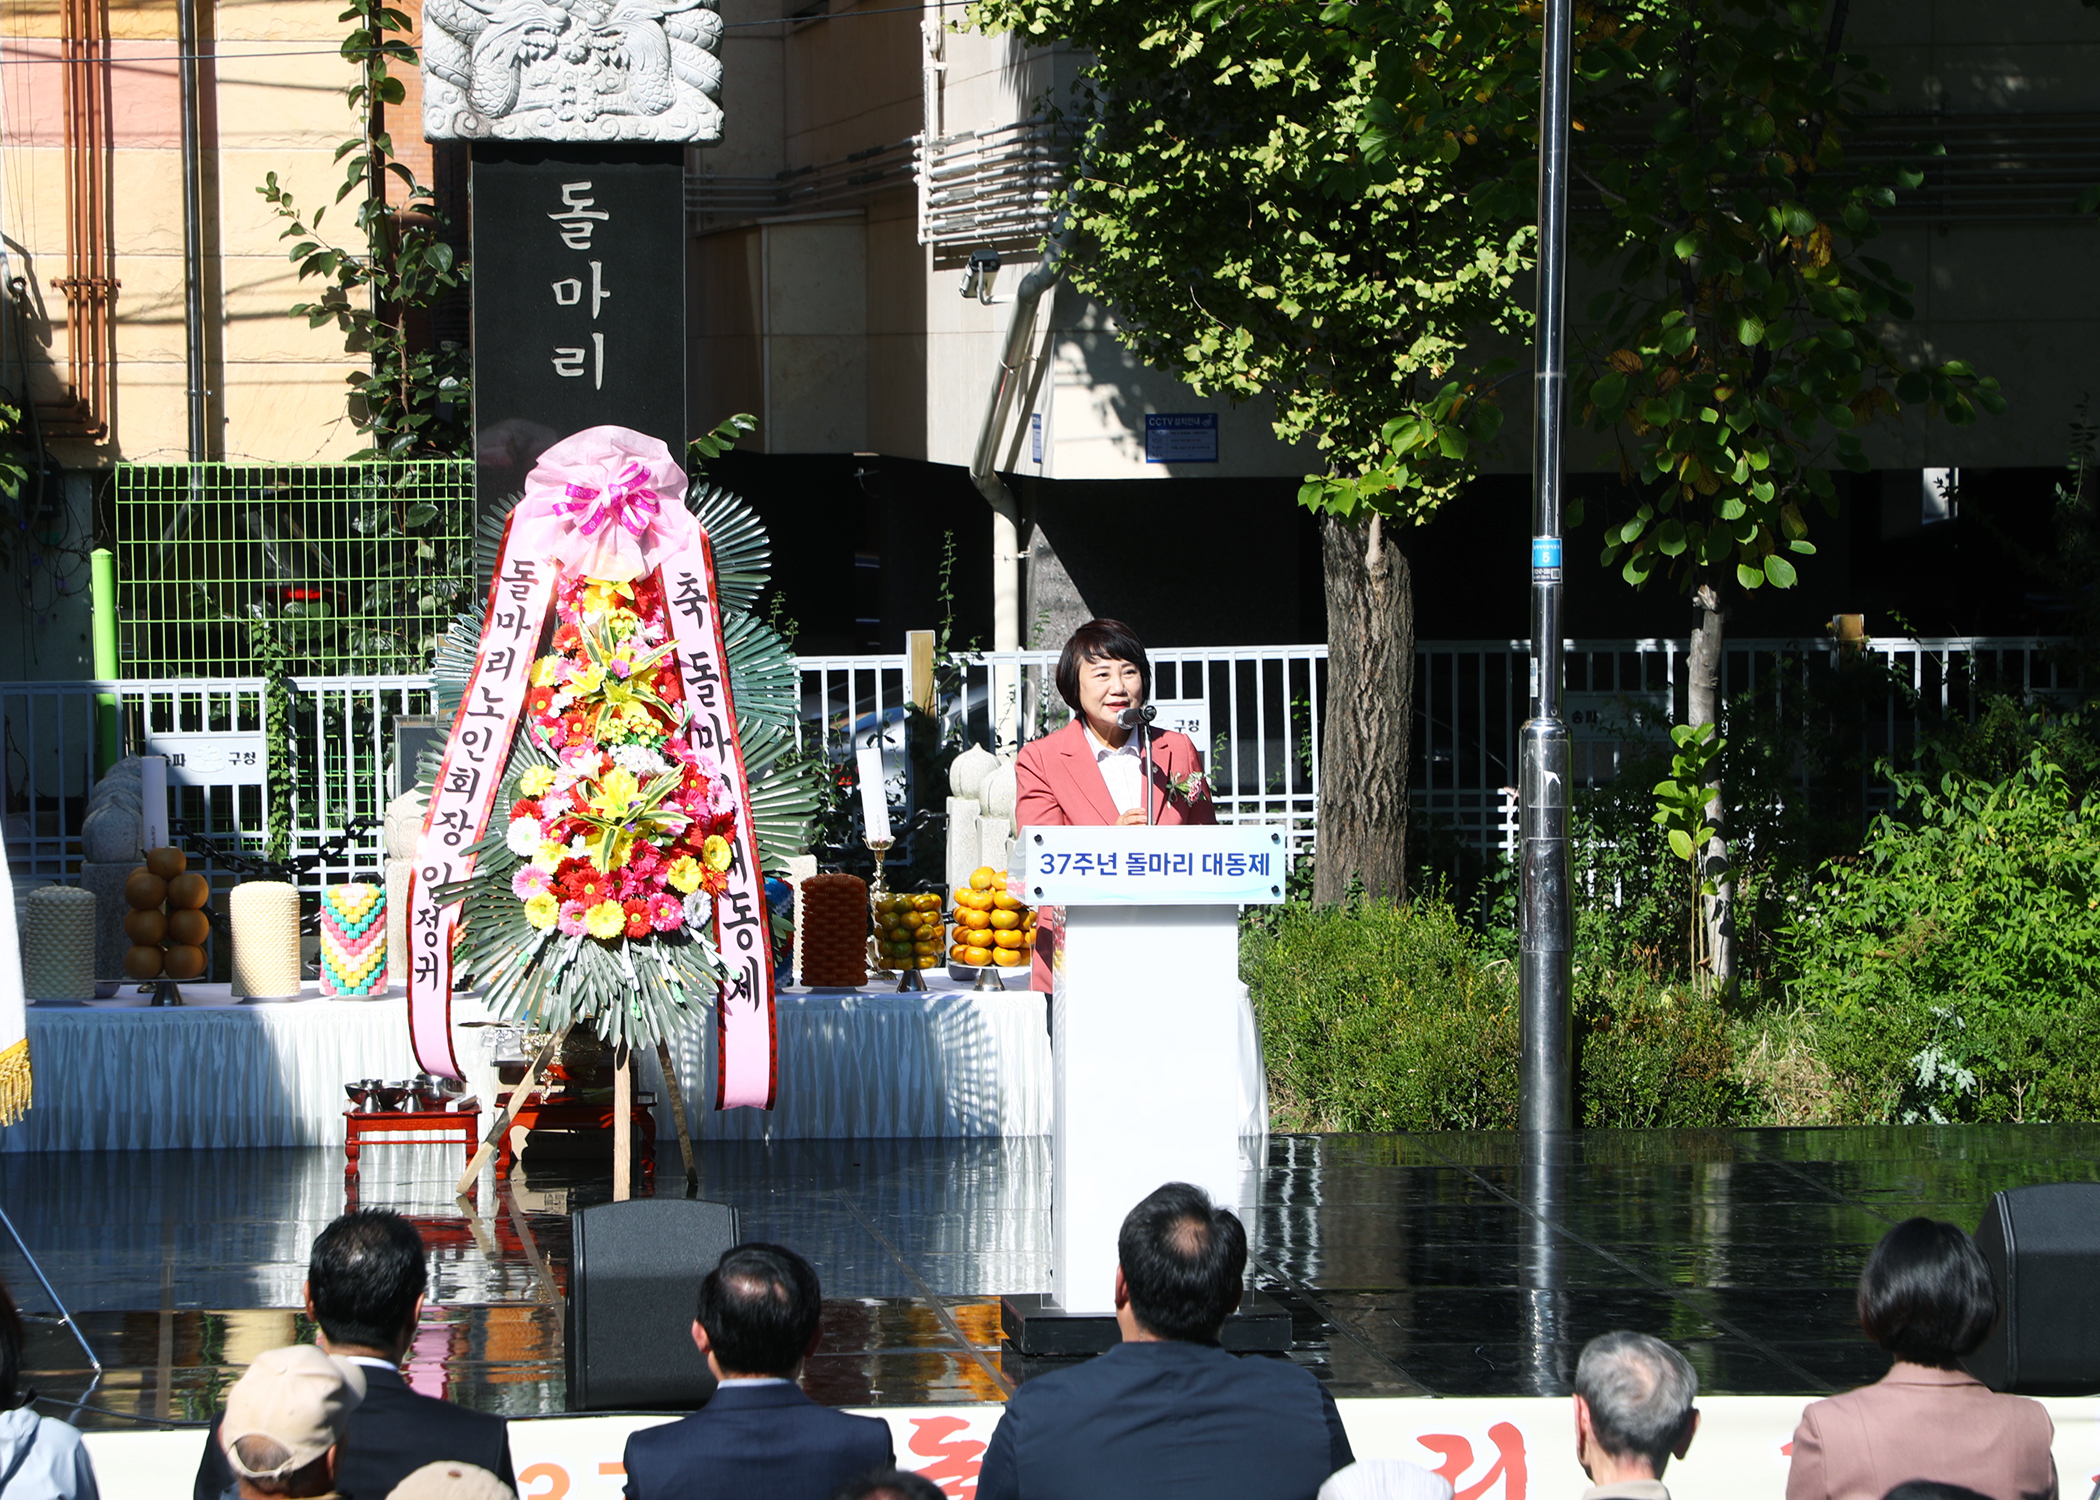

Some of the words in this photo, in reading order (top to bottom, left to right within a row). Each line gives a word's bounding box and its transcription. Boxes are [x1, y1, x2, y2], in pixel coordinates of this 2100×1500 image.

[547, 180, 611, 390] 돌마리
[1149, 418, 1173, 426] CCTV
[672, 572, 708, 629] 축
[685, 651, 733, 794] 돌마
[1174, 719, 1199, 732] 구청
[228, 752, 256, 765] 구청
[1039, 852, 1118, 876] 37주년
[1125, 852, 1194, 876] 돌마리
[1202, 852, 1270, 876] 대동제
